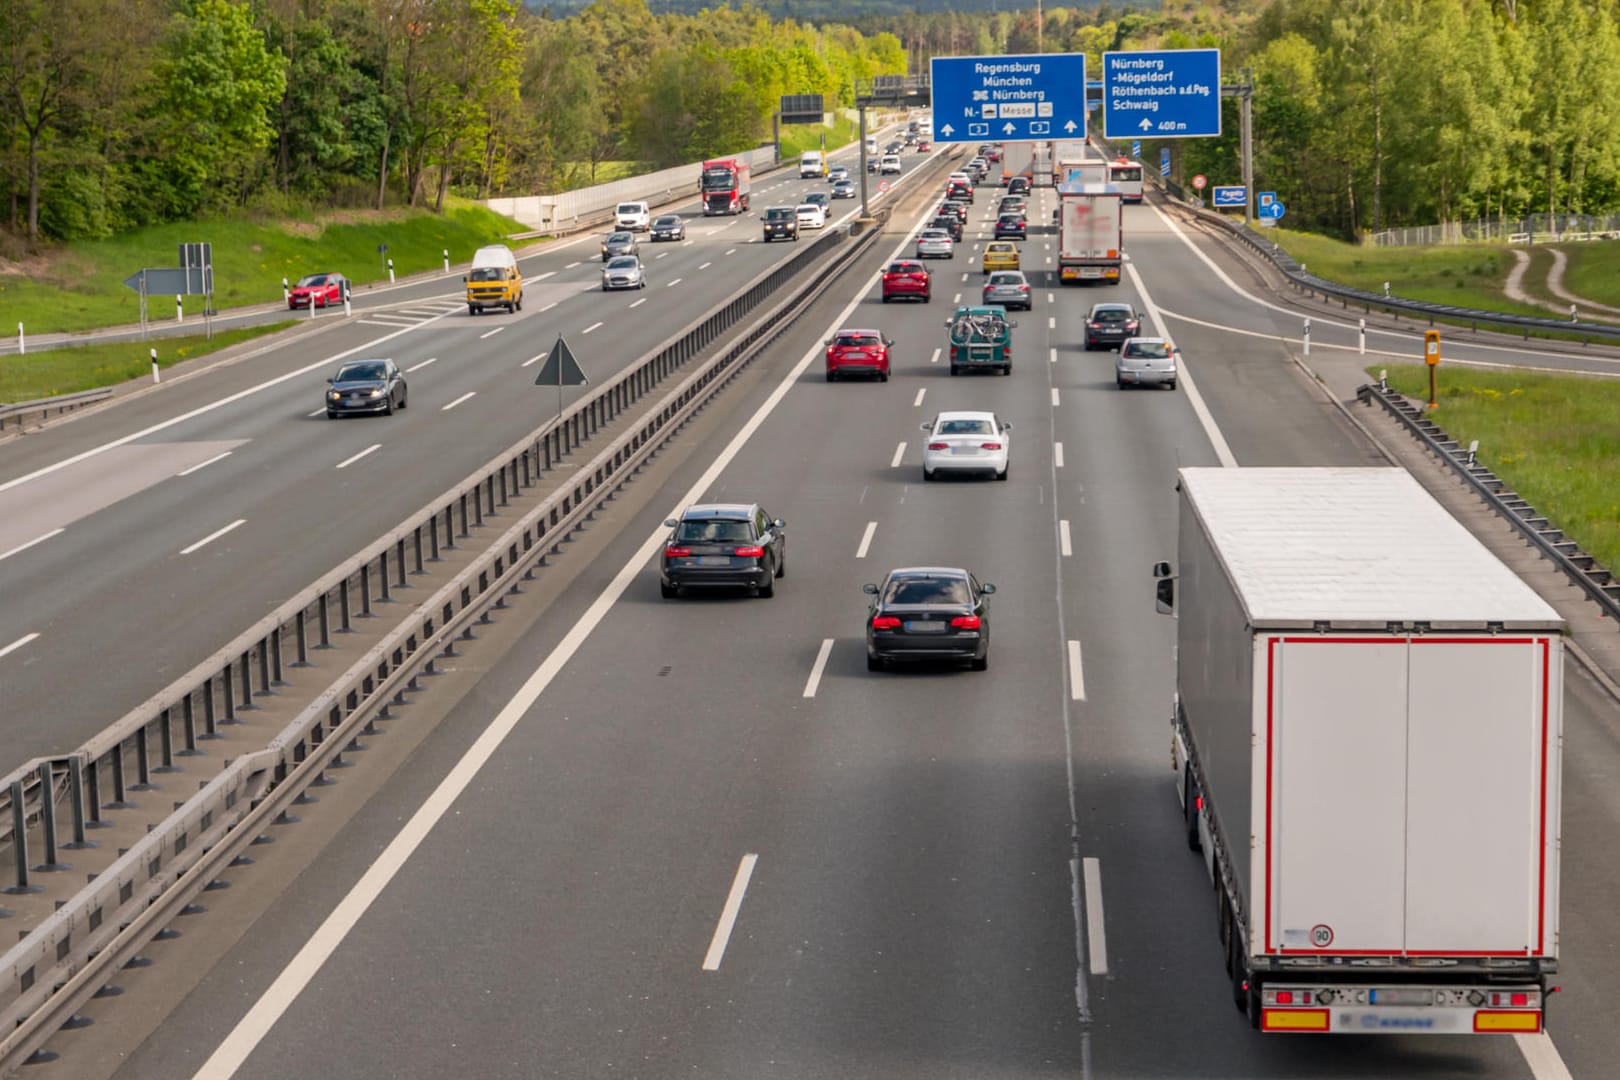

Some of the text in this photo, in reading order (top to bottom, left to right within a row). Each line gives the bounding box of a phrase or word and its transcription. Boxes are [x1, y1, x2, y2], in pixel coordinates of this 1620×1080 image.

[975, 62, 1041, 75] Regensburg
[1111, 58, 1164, 71] Nürnberg
[983, 76, 1032, 86] München
[1112, 71, 1174, 85] -Mögeldorf
[992, 89, 1045, 101] Nürnberg
[1112, 85, 1177, 97] Röthenbach
[1002, 106, 1032, 115] Messe
[1113, 99, 1159, 112] Schwaig
[1158, 121, 1187, 131] 400 m
